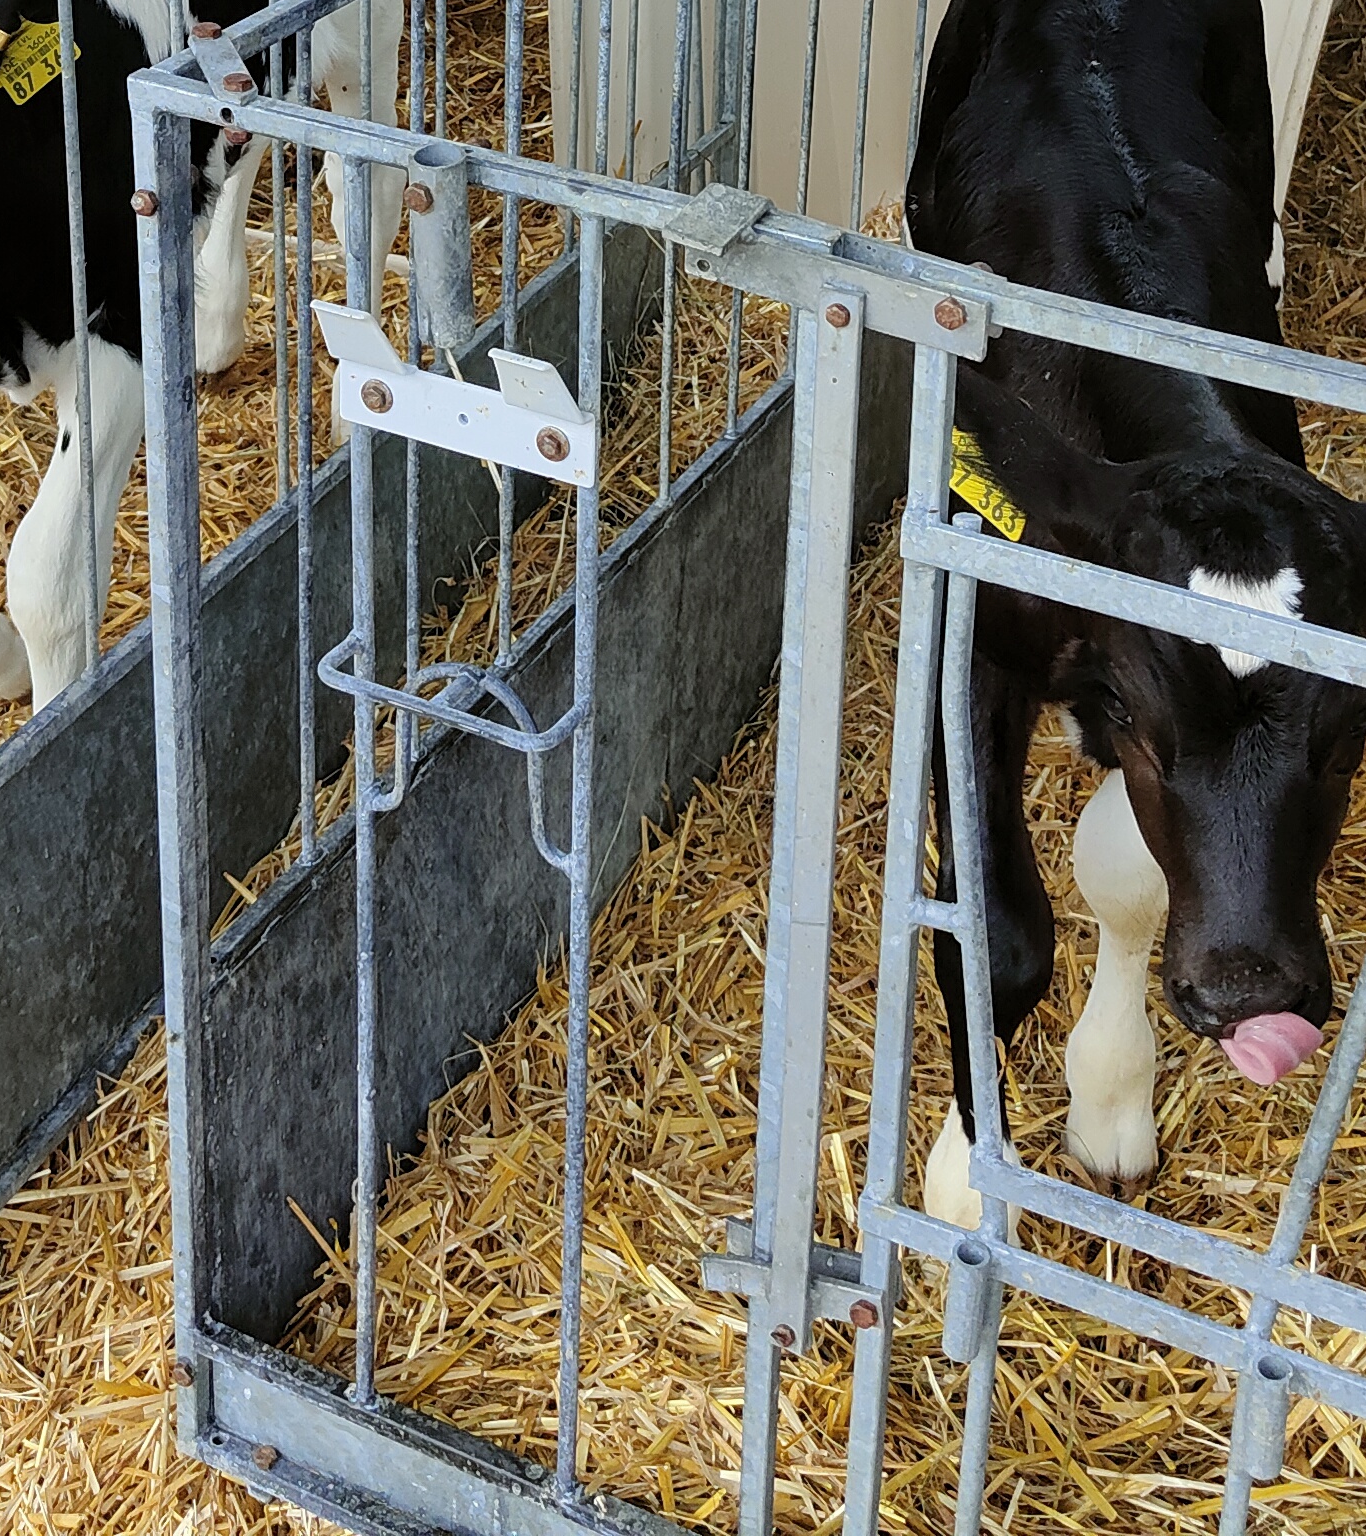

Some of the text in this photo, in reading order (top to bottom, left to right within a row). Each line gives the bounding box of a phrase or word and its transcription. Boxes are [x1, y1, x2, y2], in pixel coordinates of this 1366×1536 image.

[27, 26, 56, 51] 16046
[13, 72, 34, 100] 87
[978, 488, 1020, 533] 363
